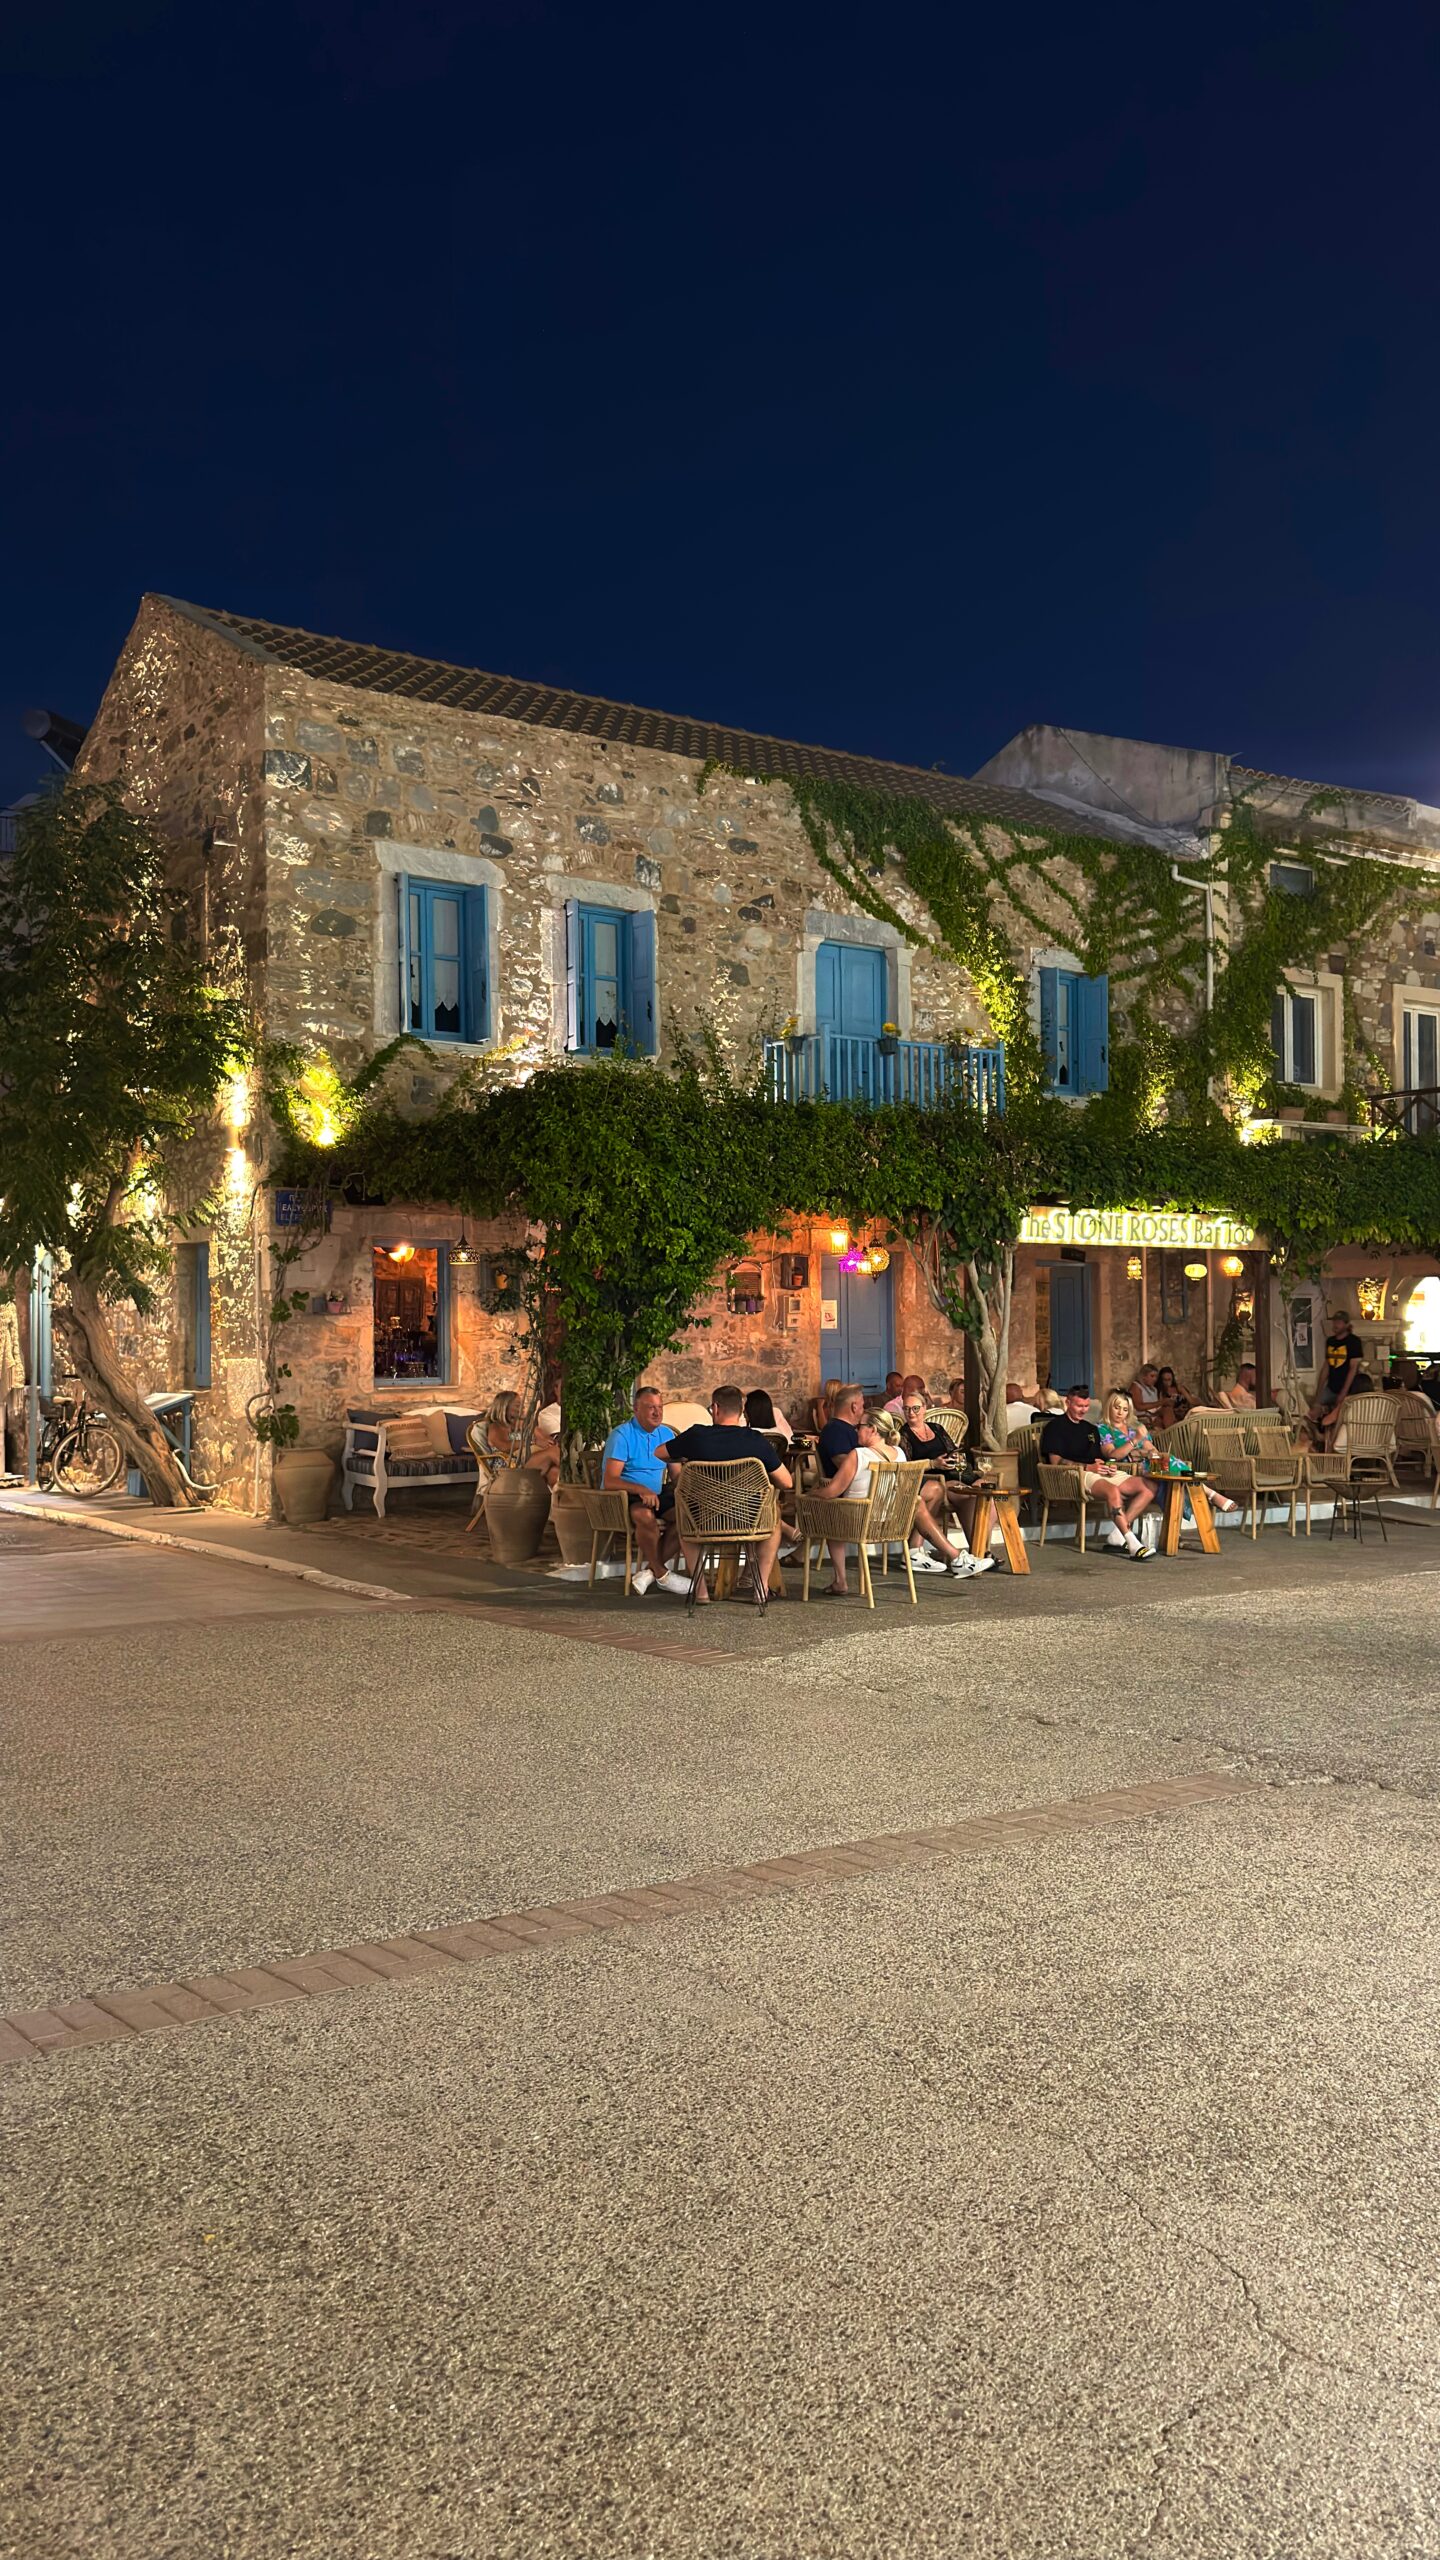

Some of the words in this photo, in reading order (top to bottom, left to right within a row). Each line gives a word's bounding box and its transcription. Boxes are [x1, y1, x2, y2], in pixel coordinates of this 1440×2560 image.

[1027, 1212, 1051, 1239] he
[1054, 1212, 1123, 1241] STONE
[1130, 1216, 1189, 1243] ROSES
[1194, 1218, 1221, 1245] Bar
